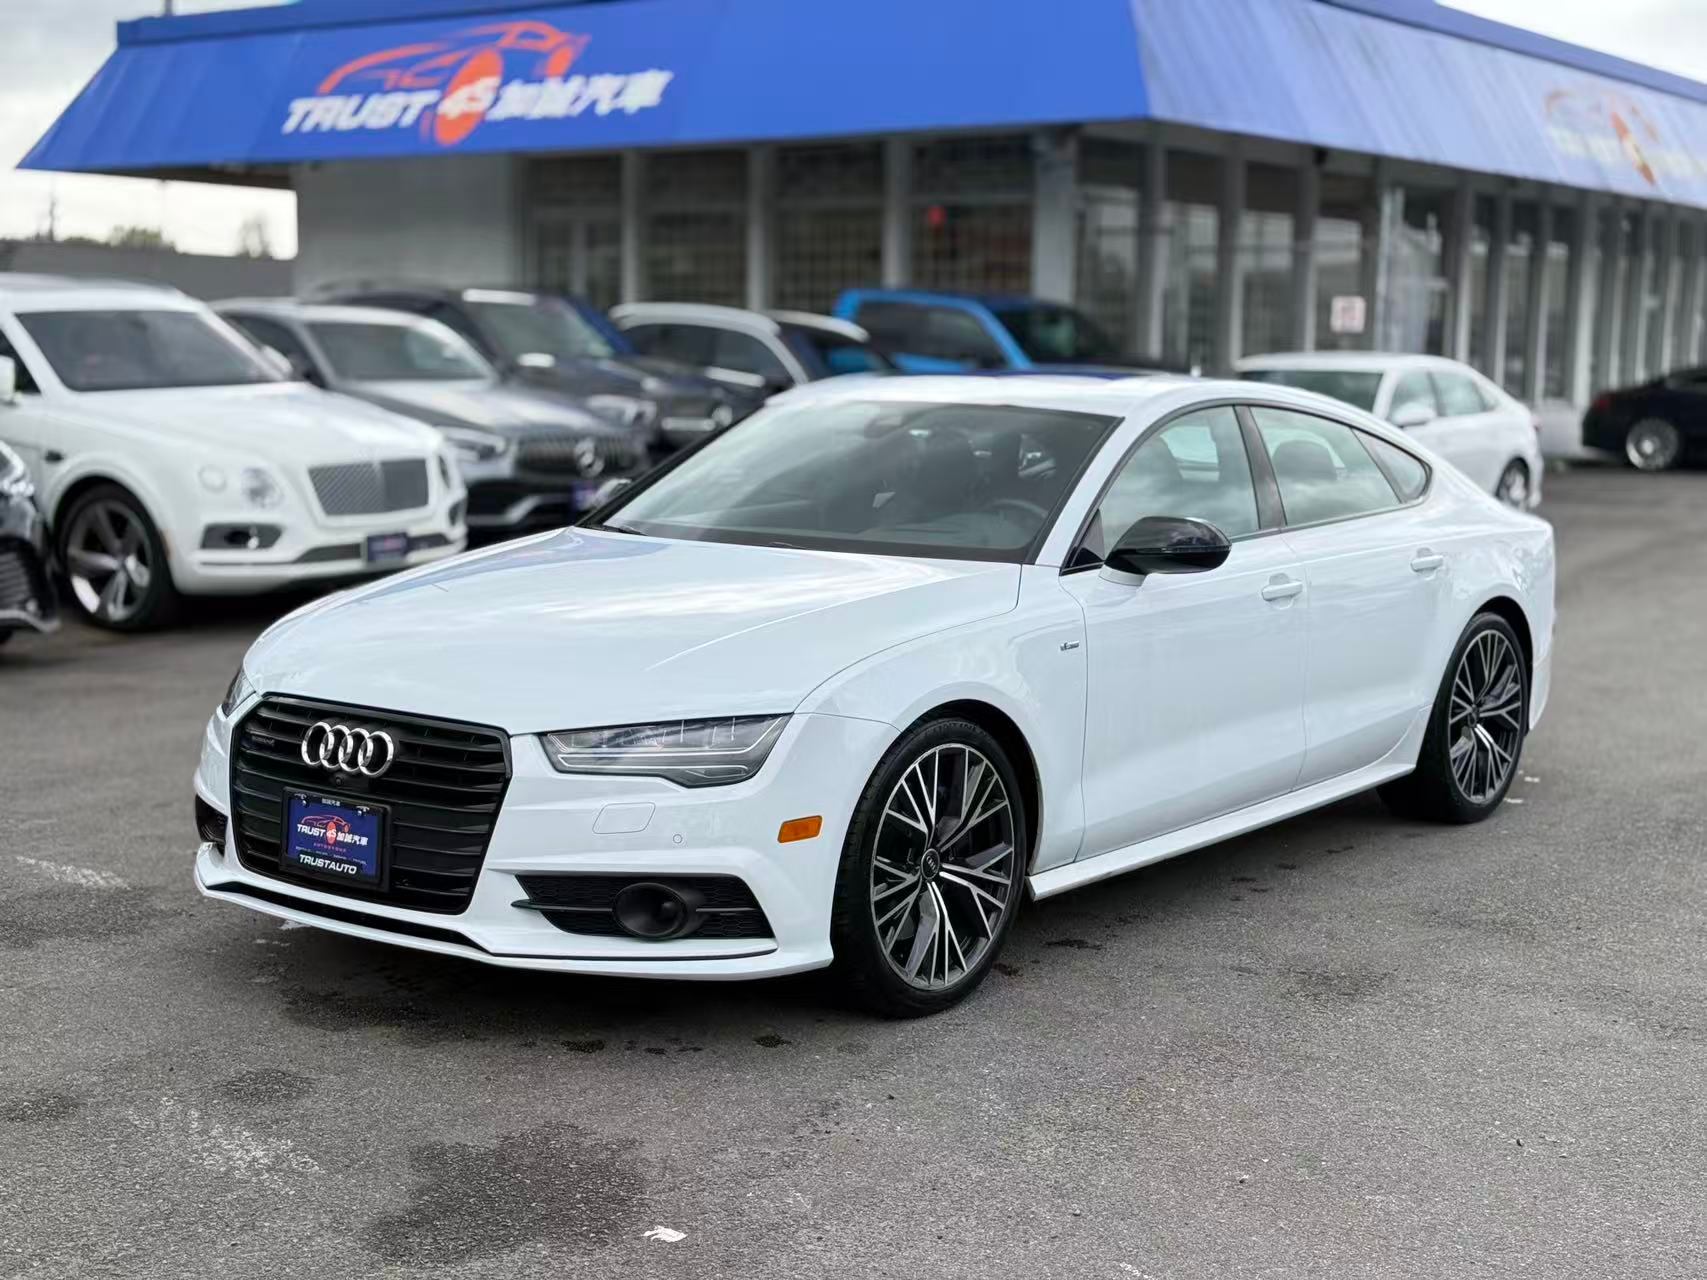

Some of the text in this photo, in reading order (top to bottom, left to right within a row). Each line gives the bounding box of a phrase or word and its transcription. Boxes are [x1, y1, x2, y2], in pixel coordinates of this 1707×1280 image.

[281, 89, 442, 135] TRUST
[297, 824, 326, 837] TRUST
[299, 854, 357, 874] TRUSTAUTO
